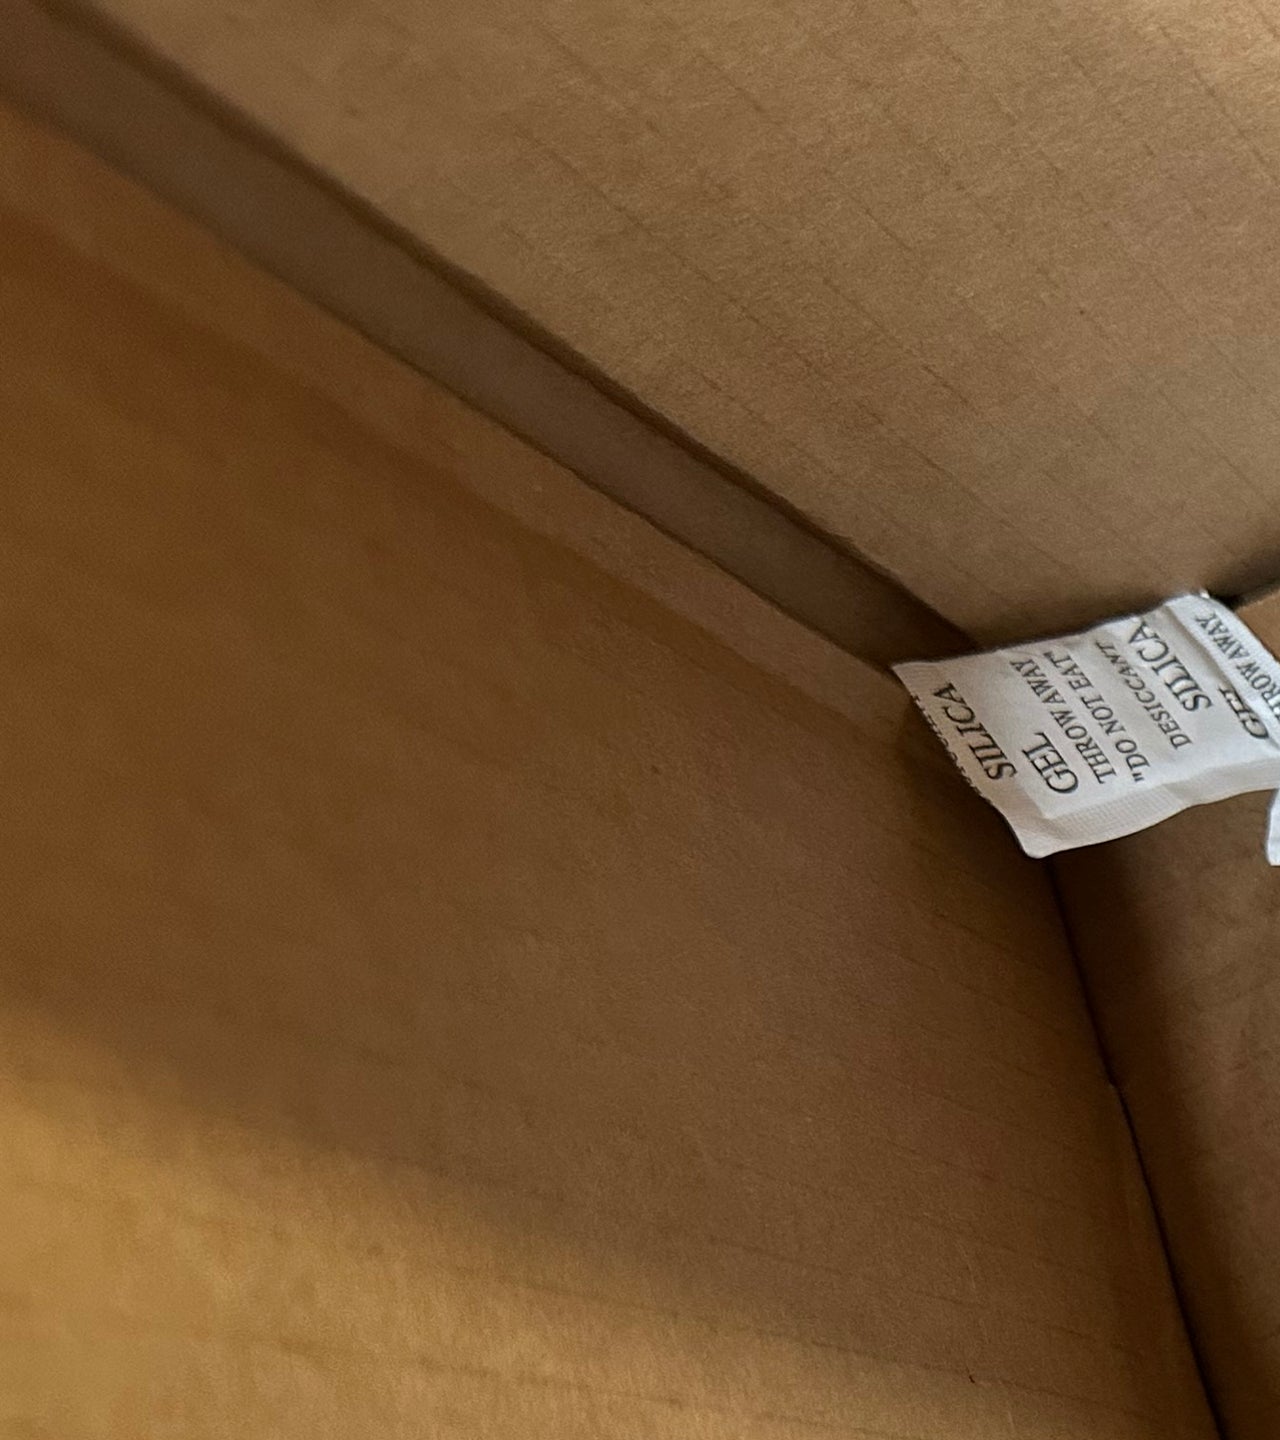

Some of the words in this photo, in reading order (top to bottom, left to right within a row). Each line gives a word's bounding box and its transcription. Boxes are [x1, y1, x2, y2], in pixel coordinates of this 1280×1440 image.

[1128, 622, 1213, 712] SILICA
[1195, 613, 1249, 660] AWAY
[1009, 659, 1066, 704] AWAY
[1095, 640, 1192, 750] DESICCANT
[933, 682, 1017, 779] SILICA
[1081, 694, 1126, 736] NOT
[1022, 732, 1079, 794] GEL
[1049, 710, 1117, 784] THROW
[1115, 739, 1150, 783] "DO
